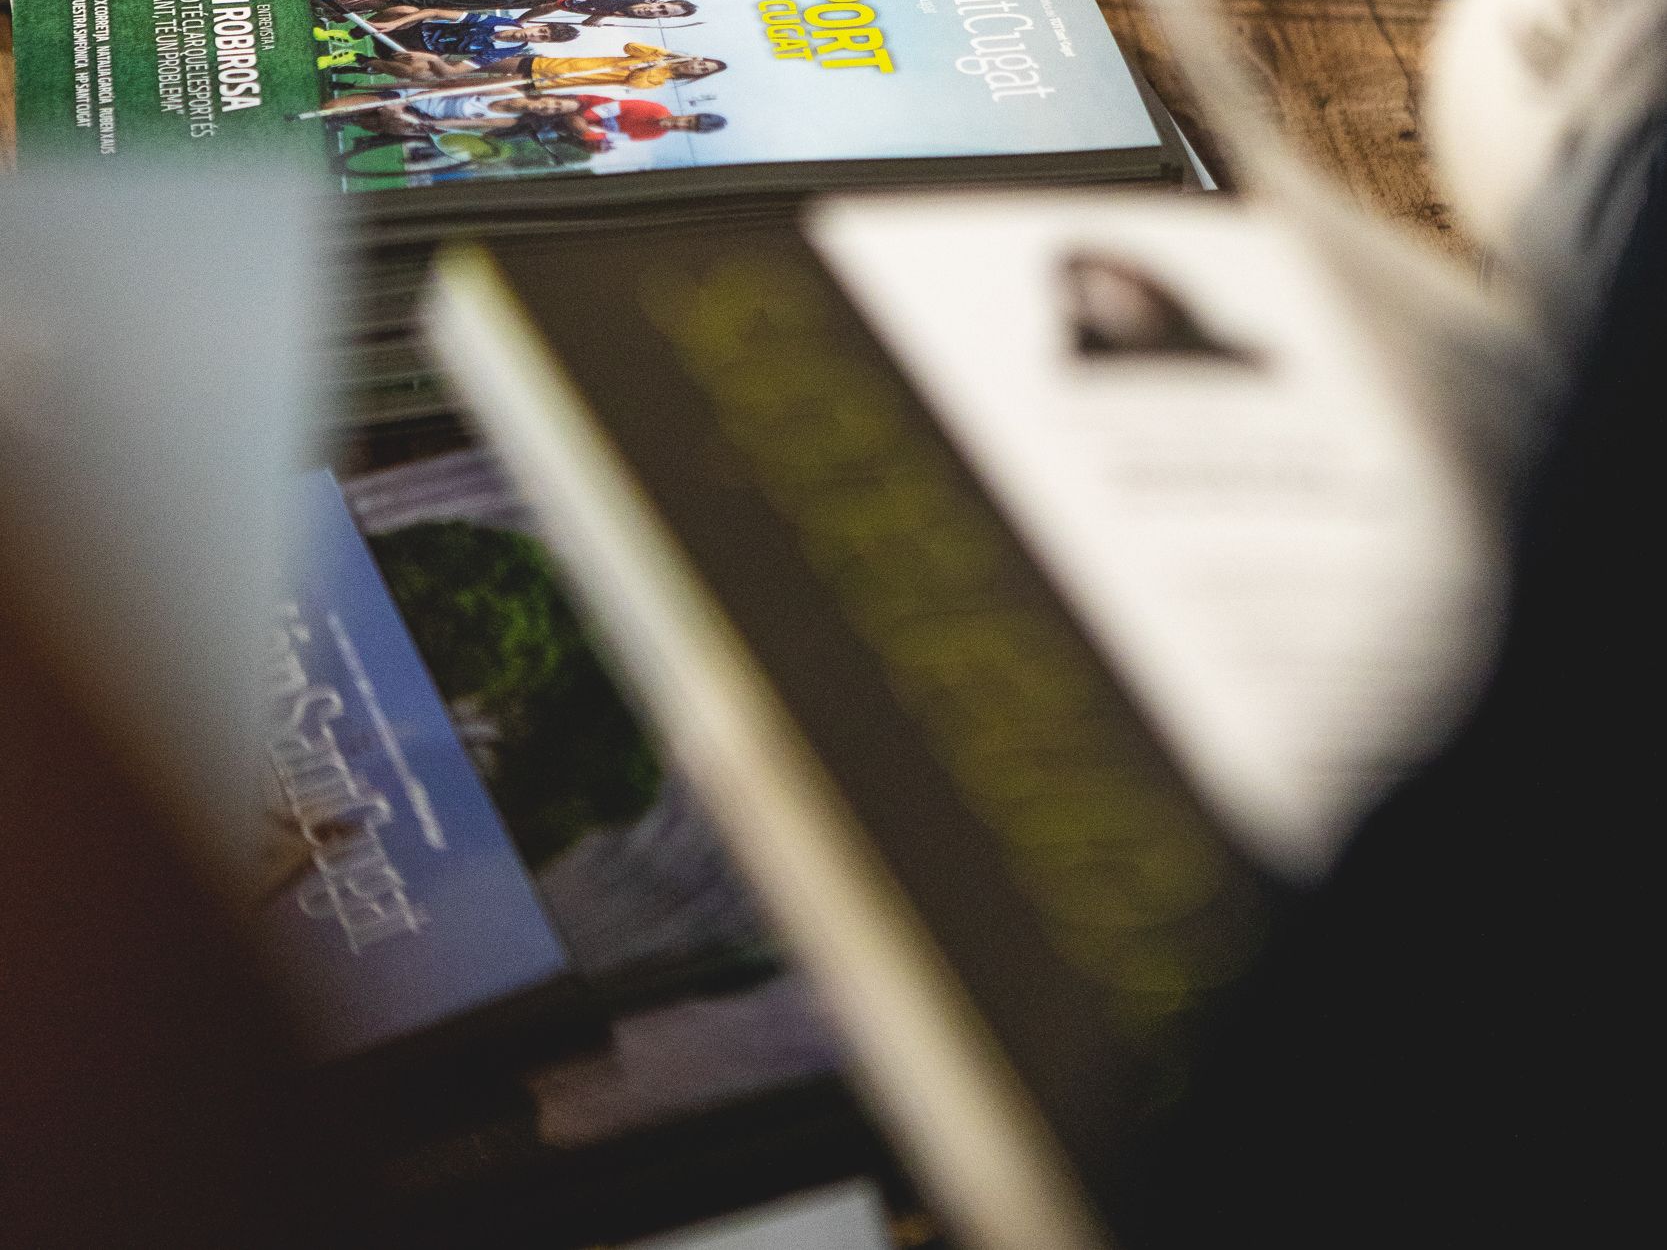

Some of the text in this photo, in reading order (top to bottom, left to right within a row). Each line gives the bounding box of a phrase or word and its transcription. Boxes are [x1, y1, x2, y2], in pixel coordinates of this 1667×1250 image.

[180, 3, 207, 18] TÉ
[93, 6, 112, 42] CORRETJA
[155, 19, 181, 34] TÉ
[181, 19, 203, 47] CLAR
[257, 4, 273, 43] ENTREVISTA
[73, 29, 92, 69] SIMFÒNICA
[156, 35, 179, 51] UN
[96, 46, 112, 77] NATALIA
[182, 48, 205, 71] QUE
[212, 8, 261, 112] ROBIROSA
[75, 73, 89, 84] HP
[97, 77, 115, 104] GARCÍA
[75, 84, 90, 104] SANT
[186, 72, 212, 122] L'ESPORT
[76, 105, 91, 127] CUGAT
[98, 108, 114, 133] RUBEN
[191, 123, 218, 137] ÉS
[100, 134, 117, 154] XAUS
